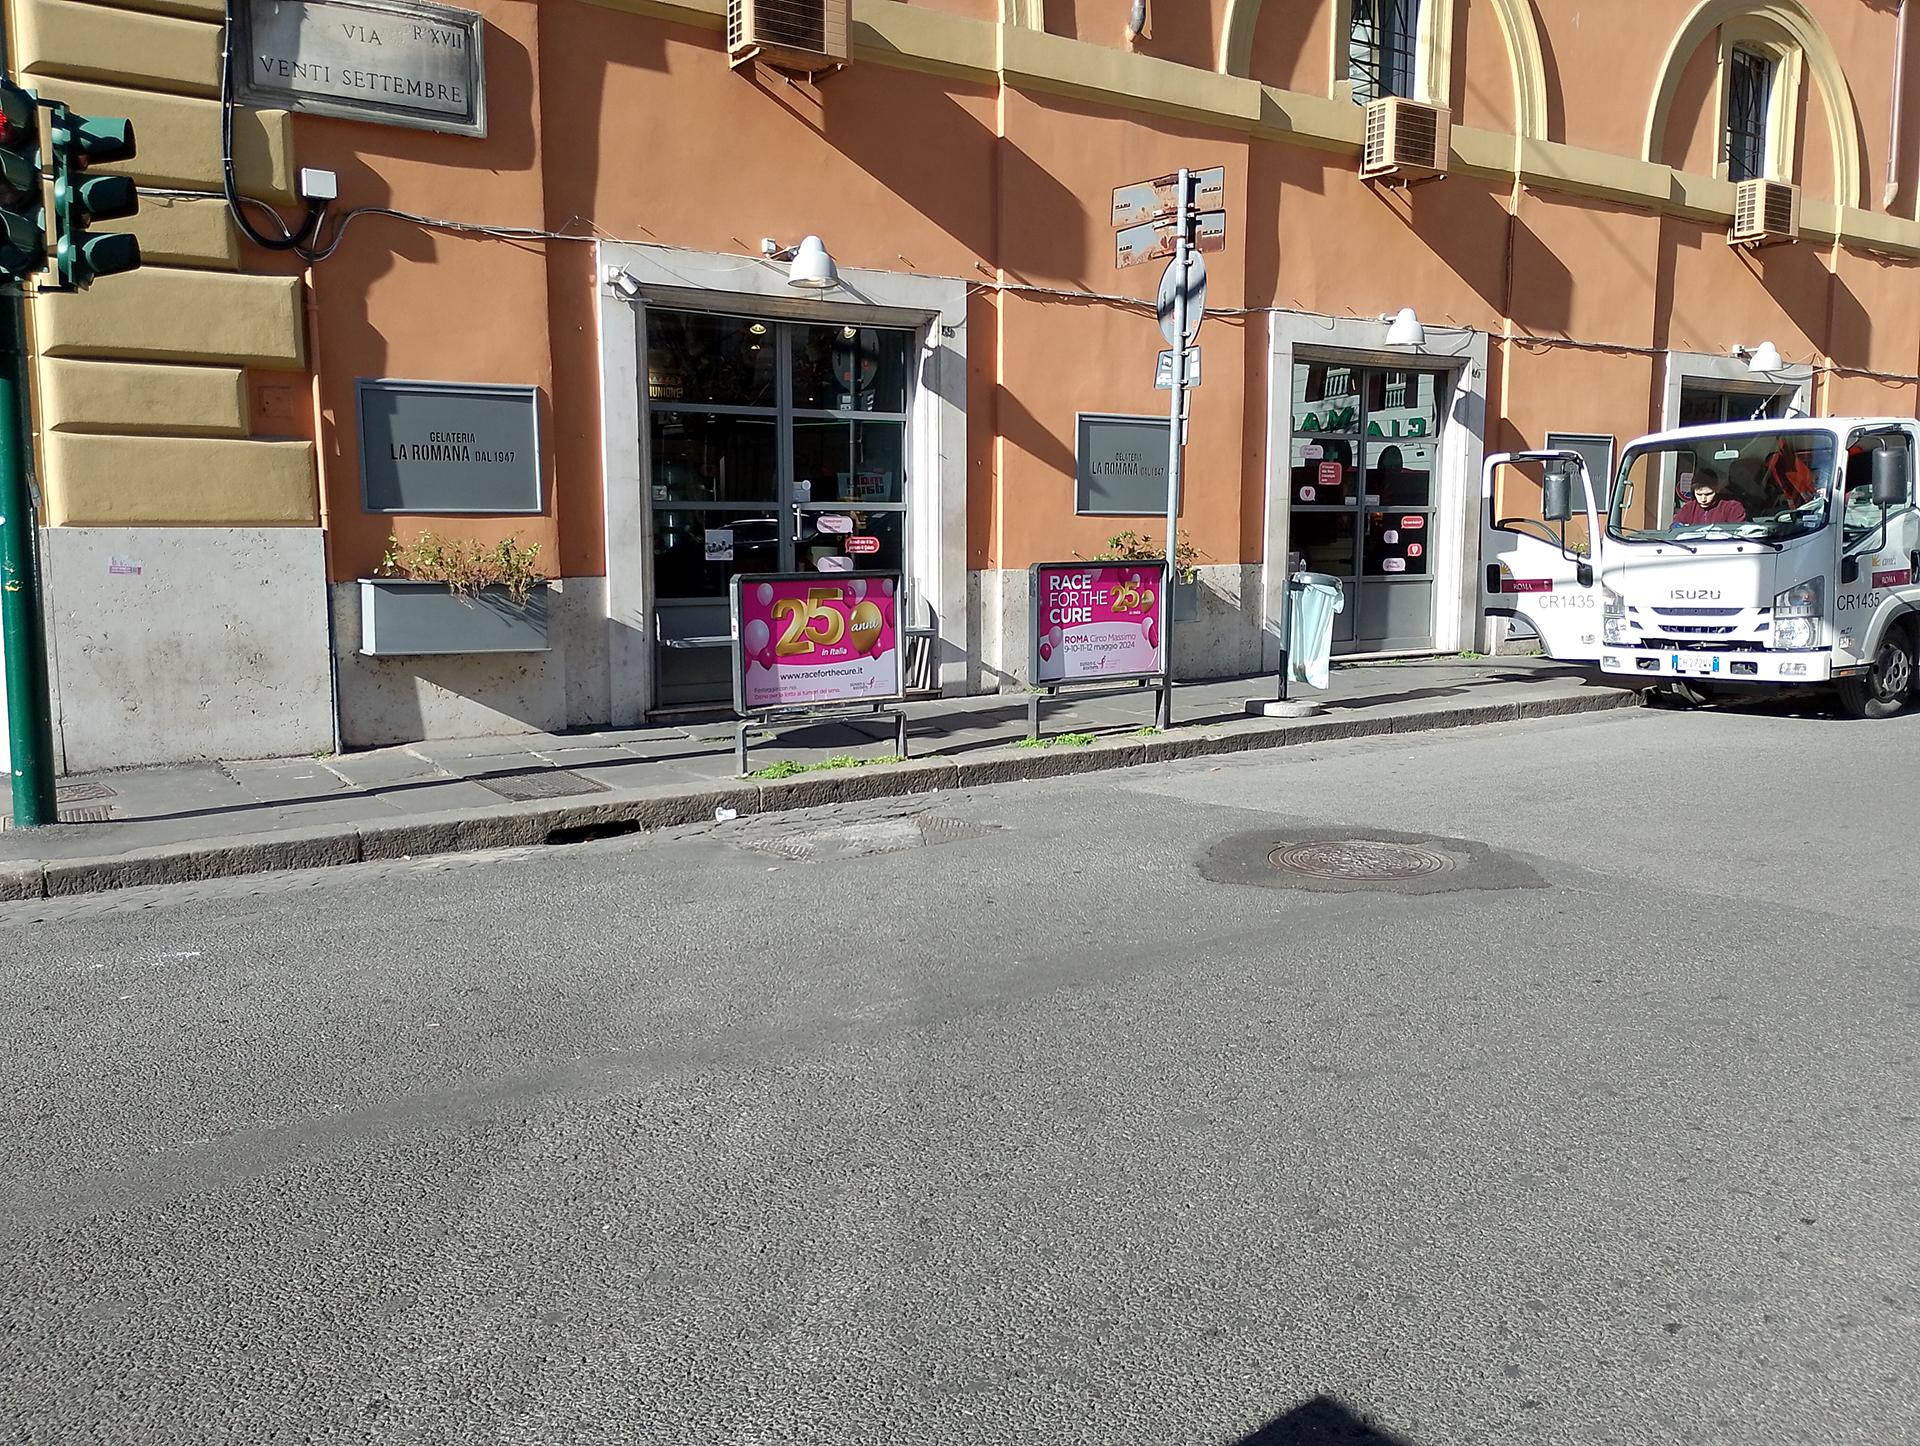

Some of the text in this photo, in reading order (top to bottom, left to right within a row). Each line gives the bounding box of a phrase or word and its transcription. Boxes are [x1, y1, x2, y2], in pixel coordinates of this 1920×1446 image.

[342, 23, 382, 46] VIA
[431, 28, 463, 49] XVII
[259, 55, 463, 103] VENTI SETTEMBRE
[430, 431, 476, 443] GELATERIA
[390, 443, 515, 463] LA ROMANA DAL 1947
[1092, 461, 1102, 475] LA
[1104, 462, 1138, 476] ROMANA
[1049, 574, 1092, 591] RACE
[1881, 576, 1897, 584] ROMA
[1049, 590, 1108, 607] FOR THE
[1110, 581, 1140, 613] 25
[1538, 595, 1595, 609] CR1435
[1670, 590, 1721, 600] ISUZU
[1837, 592, 1880, 611] CR1435
[771, 588, 845, 657] 25
[1049, 607, 1092, 624] CURE
[851, 619, 879, 632] anni
[1064, 633, 1137, 645] ROMA Circo Massimo
[821, 647, 848, 656] in Italia
[1064, 641, 1135, 653] 9-10-11-12 maggio 2024
[780, 667, 863, 681] www.raceforthecure.it
